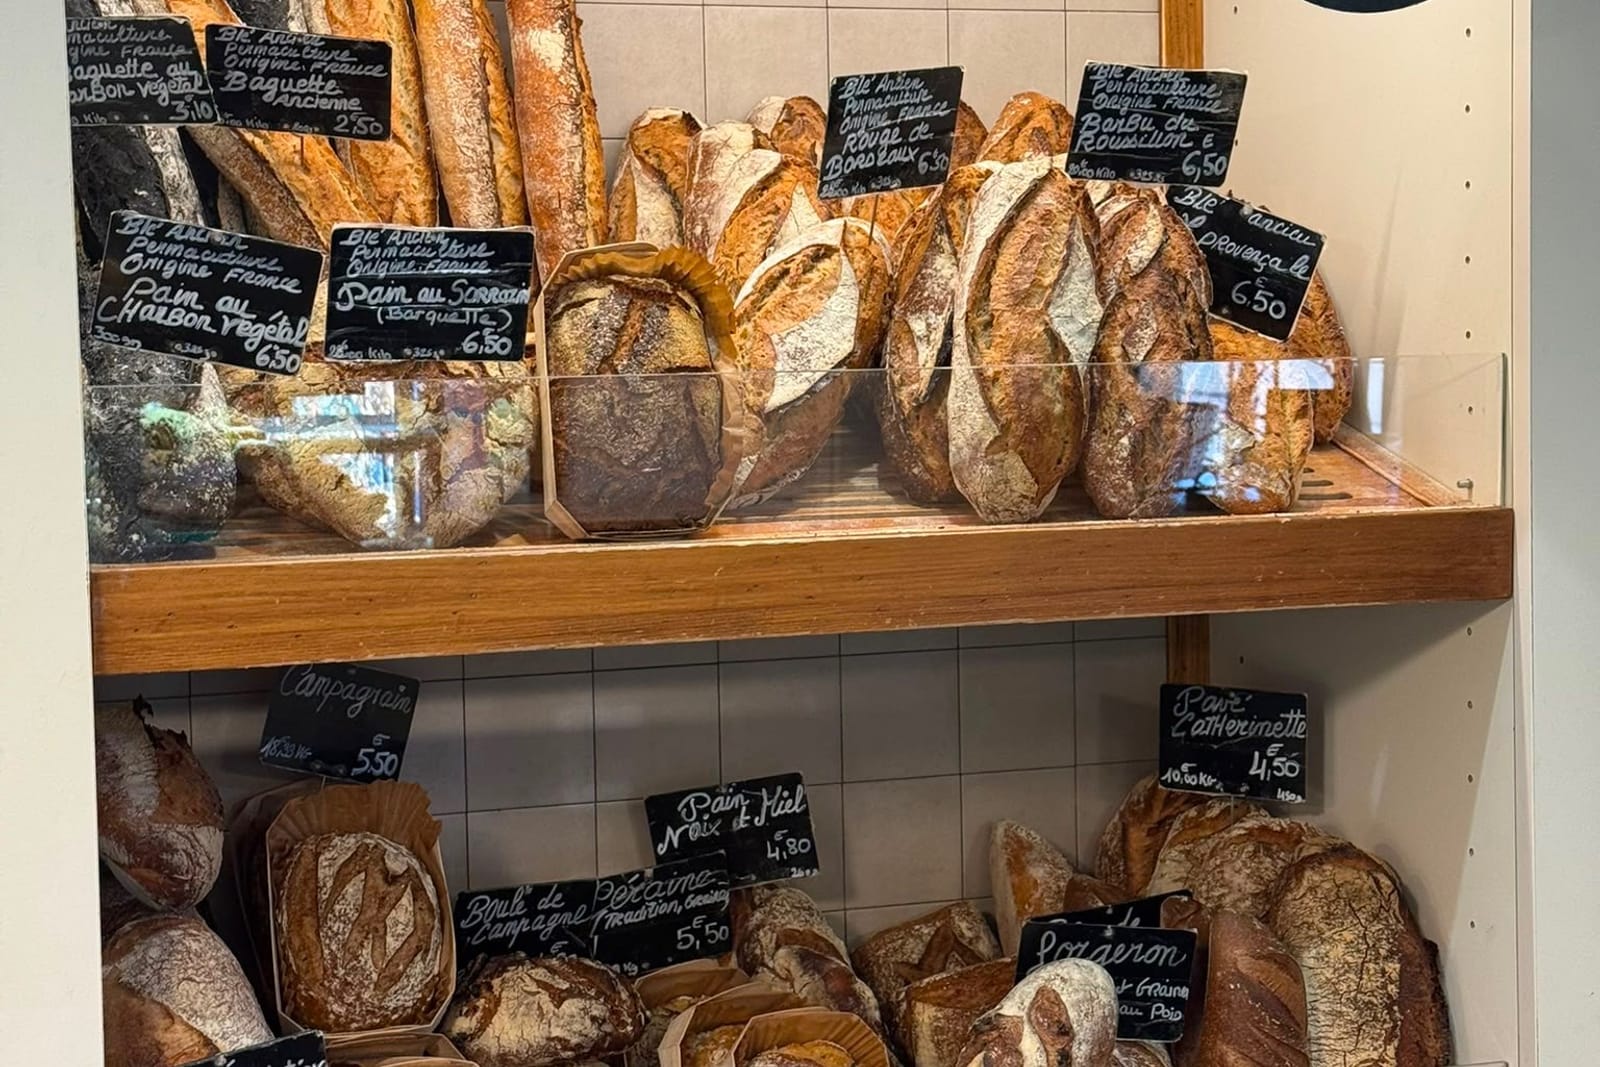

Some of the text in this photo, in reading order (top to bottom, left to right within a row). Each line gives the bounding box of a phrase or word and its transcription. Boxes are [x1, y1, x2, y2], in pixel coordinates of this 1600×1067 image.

[67, 25, 172, 44] maculture
[166, 62, 199, 77] au
[219, 69, 344, 104] Baguette
[271, 93, 363, 112] Ancienne
[908, 121, 934, 143] de
[1074, 128, 1194, 153] Roussillon
[122, 277, 256, 319] Pain au
[335, 280, 413, 311] Pain
[417, 286, 446, 303] au
[677, 789, 750, 823] Pain
[657, 812, 723, 856] Noix
[537, 883, 565, 910] de
